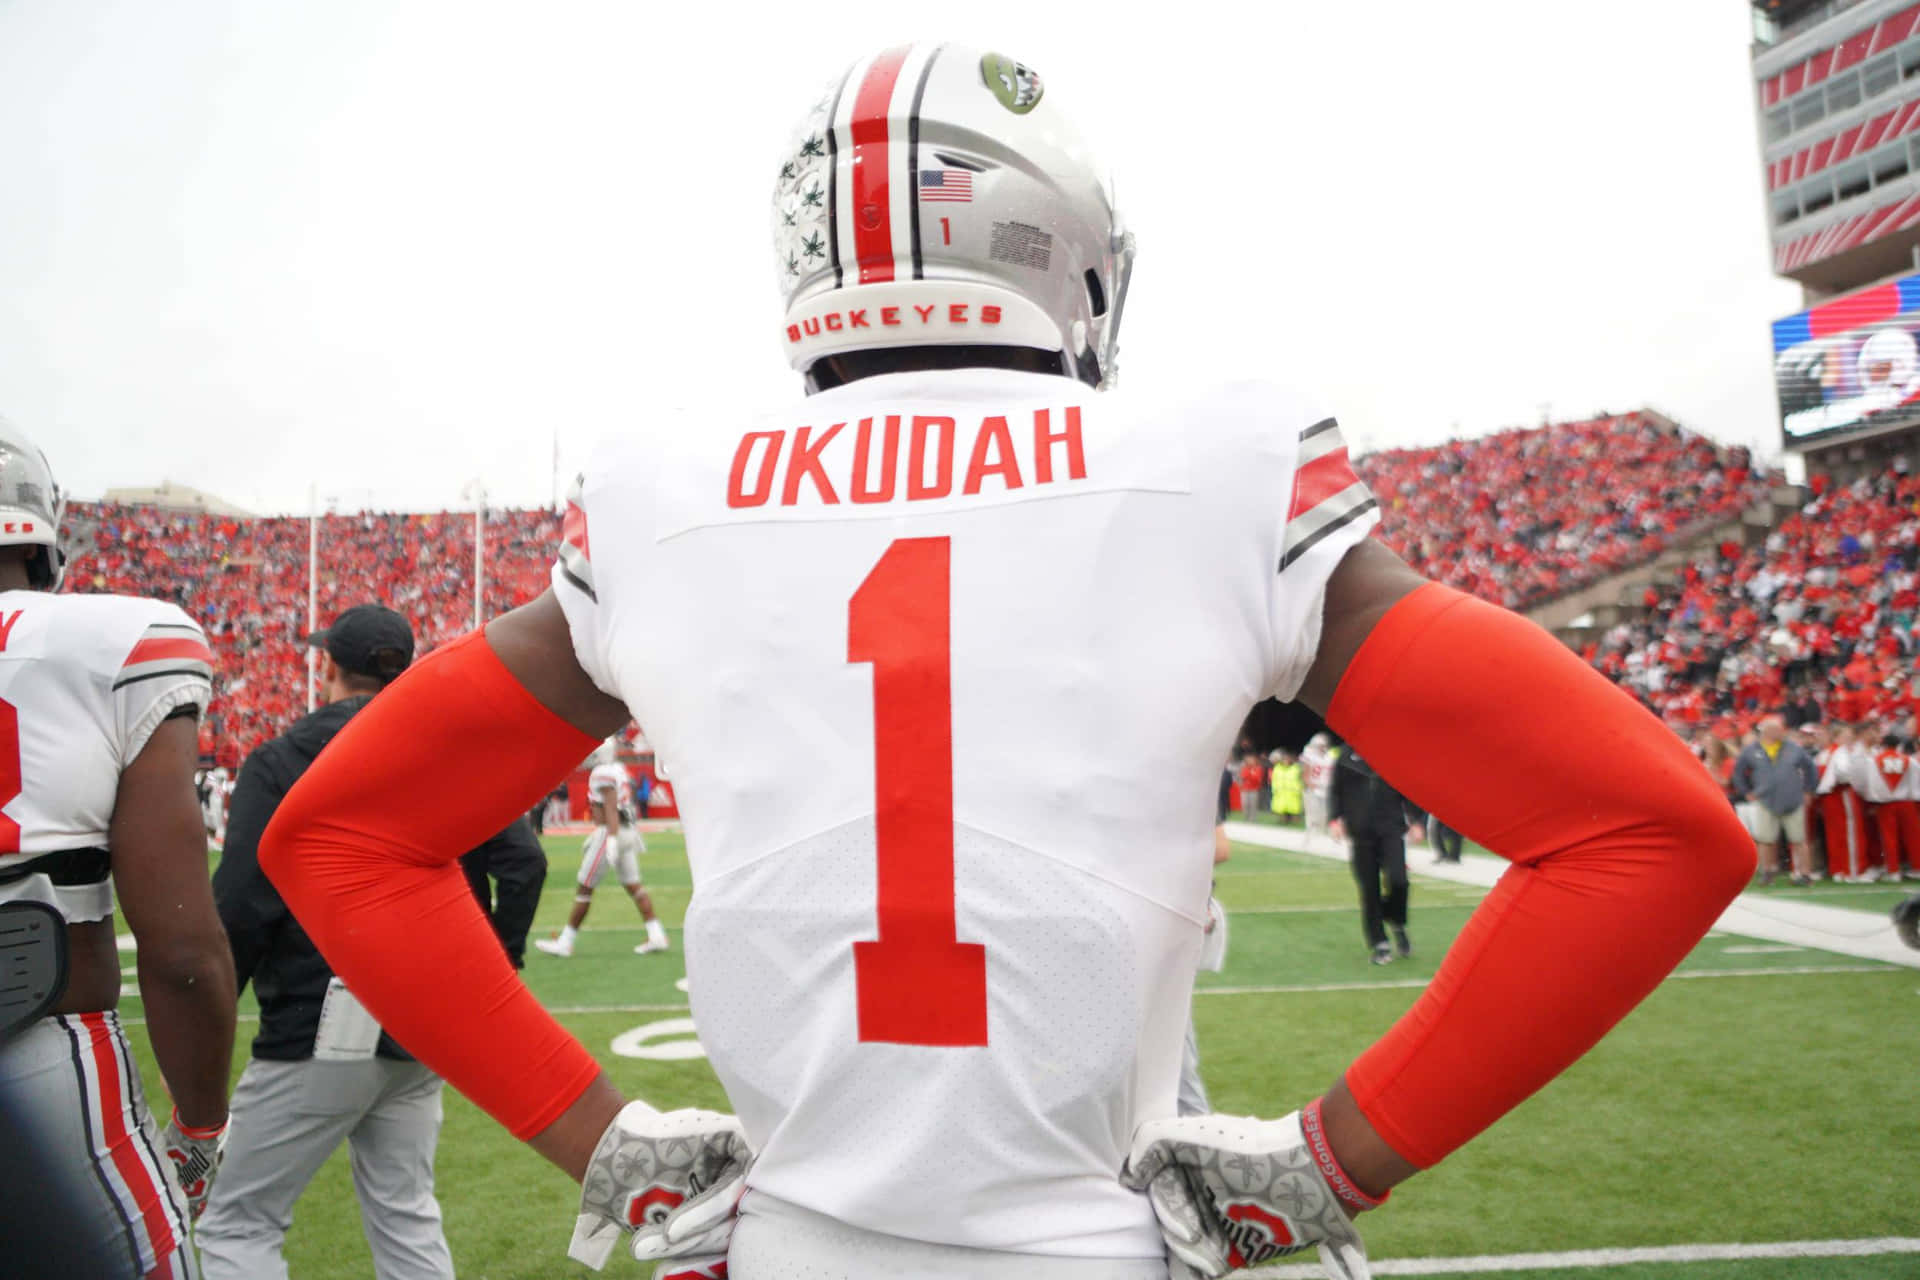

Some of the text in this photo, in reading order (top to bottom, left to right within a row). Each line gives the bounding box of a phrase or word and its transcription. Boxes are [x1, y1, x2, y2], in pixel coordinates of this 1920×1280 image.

[938, 216, 951, 246] 1
[786, 304, 1002, 343] BUCKEYES
[726, 406, 1087, 508] OKUDAH
[847, 536, 988, 1047] 1
